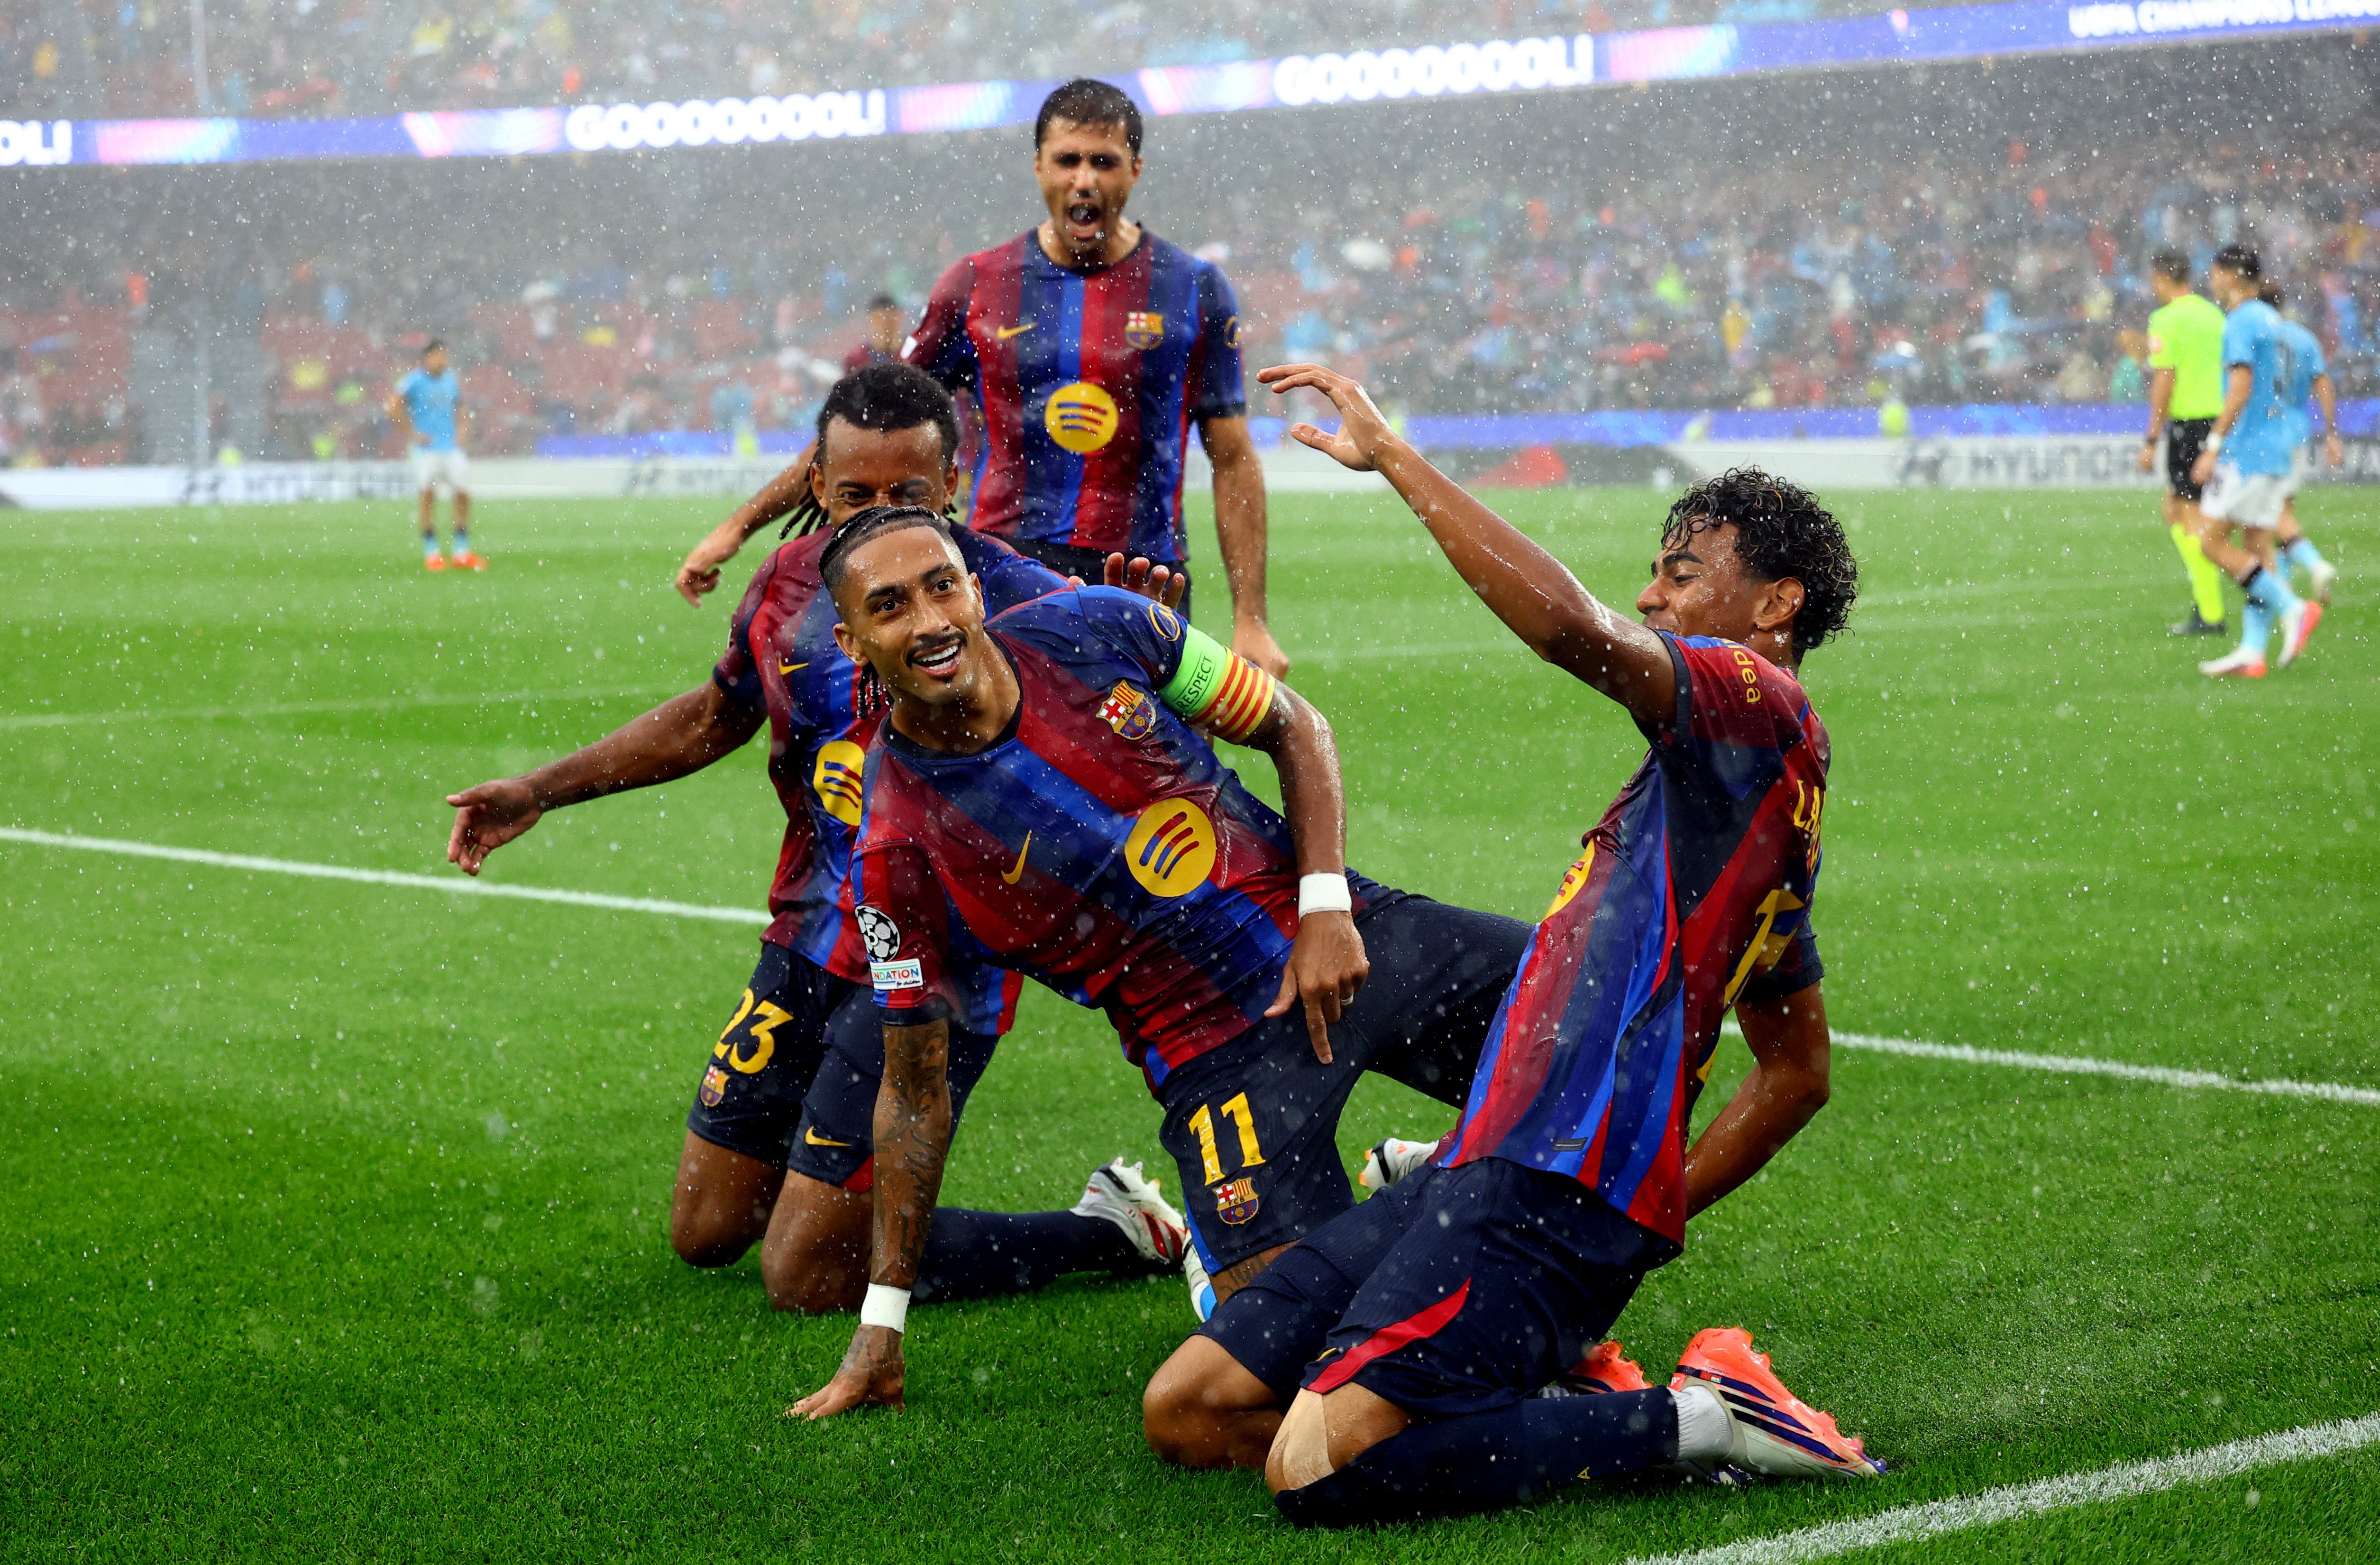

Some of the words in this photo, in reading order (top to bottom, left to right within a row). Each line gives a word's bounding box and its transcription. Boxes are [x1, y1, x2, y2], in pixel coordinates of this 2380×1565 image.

[1176, 655, 1213, 710] RESPECT
[714, 987, 795, 1074] 23
[1188, 1091, 1267, 1187] 11
[1228, 1197, 1245, 1207] FCB
